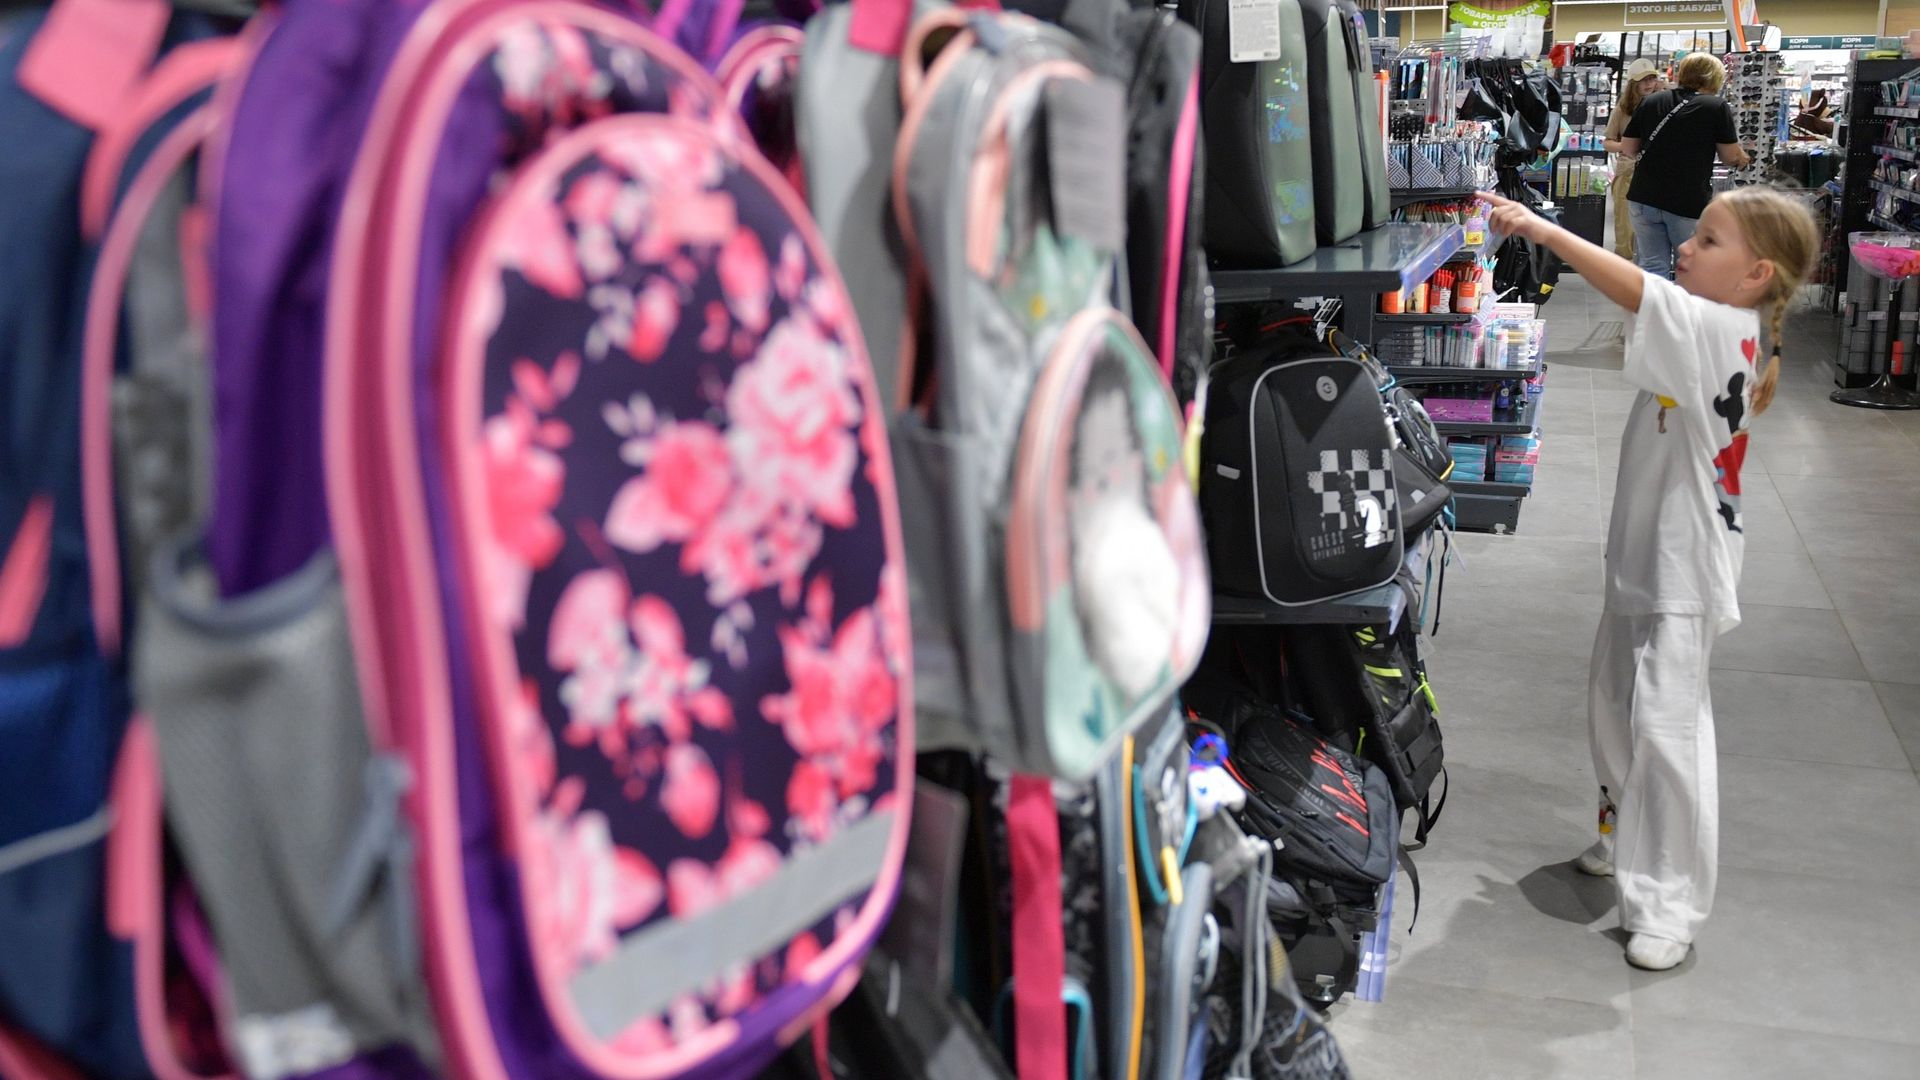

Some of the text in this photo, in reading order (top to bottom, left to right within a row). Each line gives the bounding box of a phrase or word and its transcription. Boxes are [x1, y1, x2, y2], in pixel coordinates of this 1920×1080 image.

[1459, 4, 1495, 21] ТОВАРЫ
[1514, 3, 1540, 16] САДА
[1630, 5, 1662, 13] ЭТОГО
[1663, 5, 1677, 13] НЕ
[1310, 530, 1344, 550] CHESS
